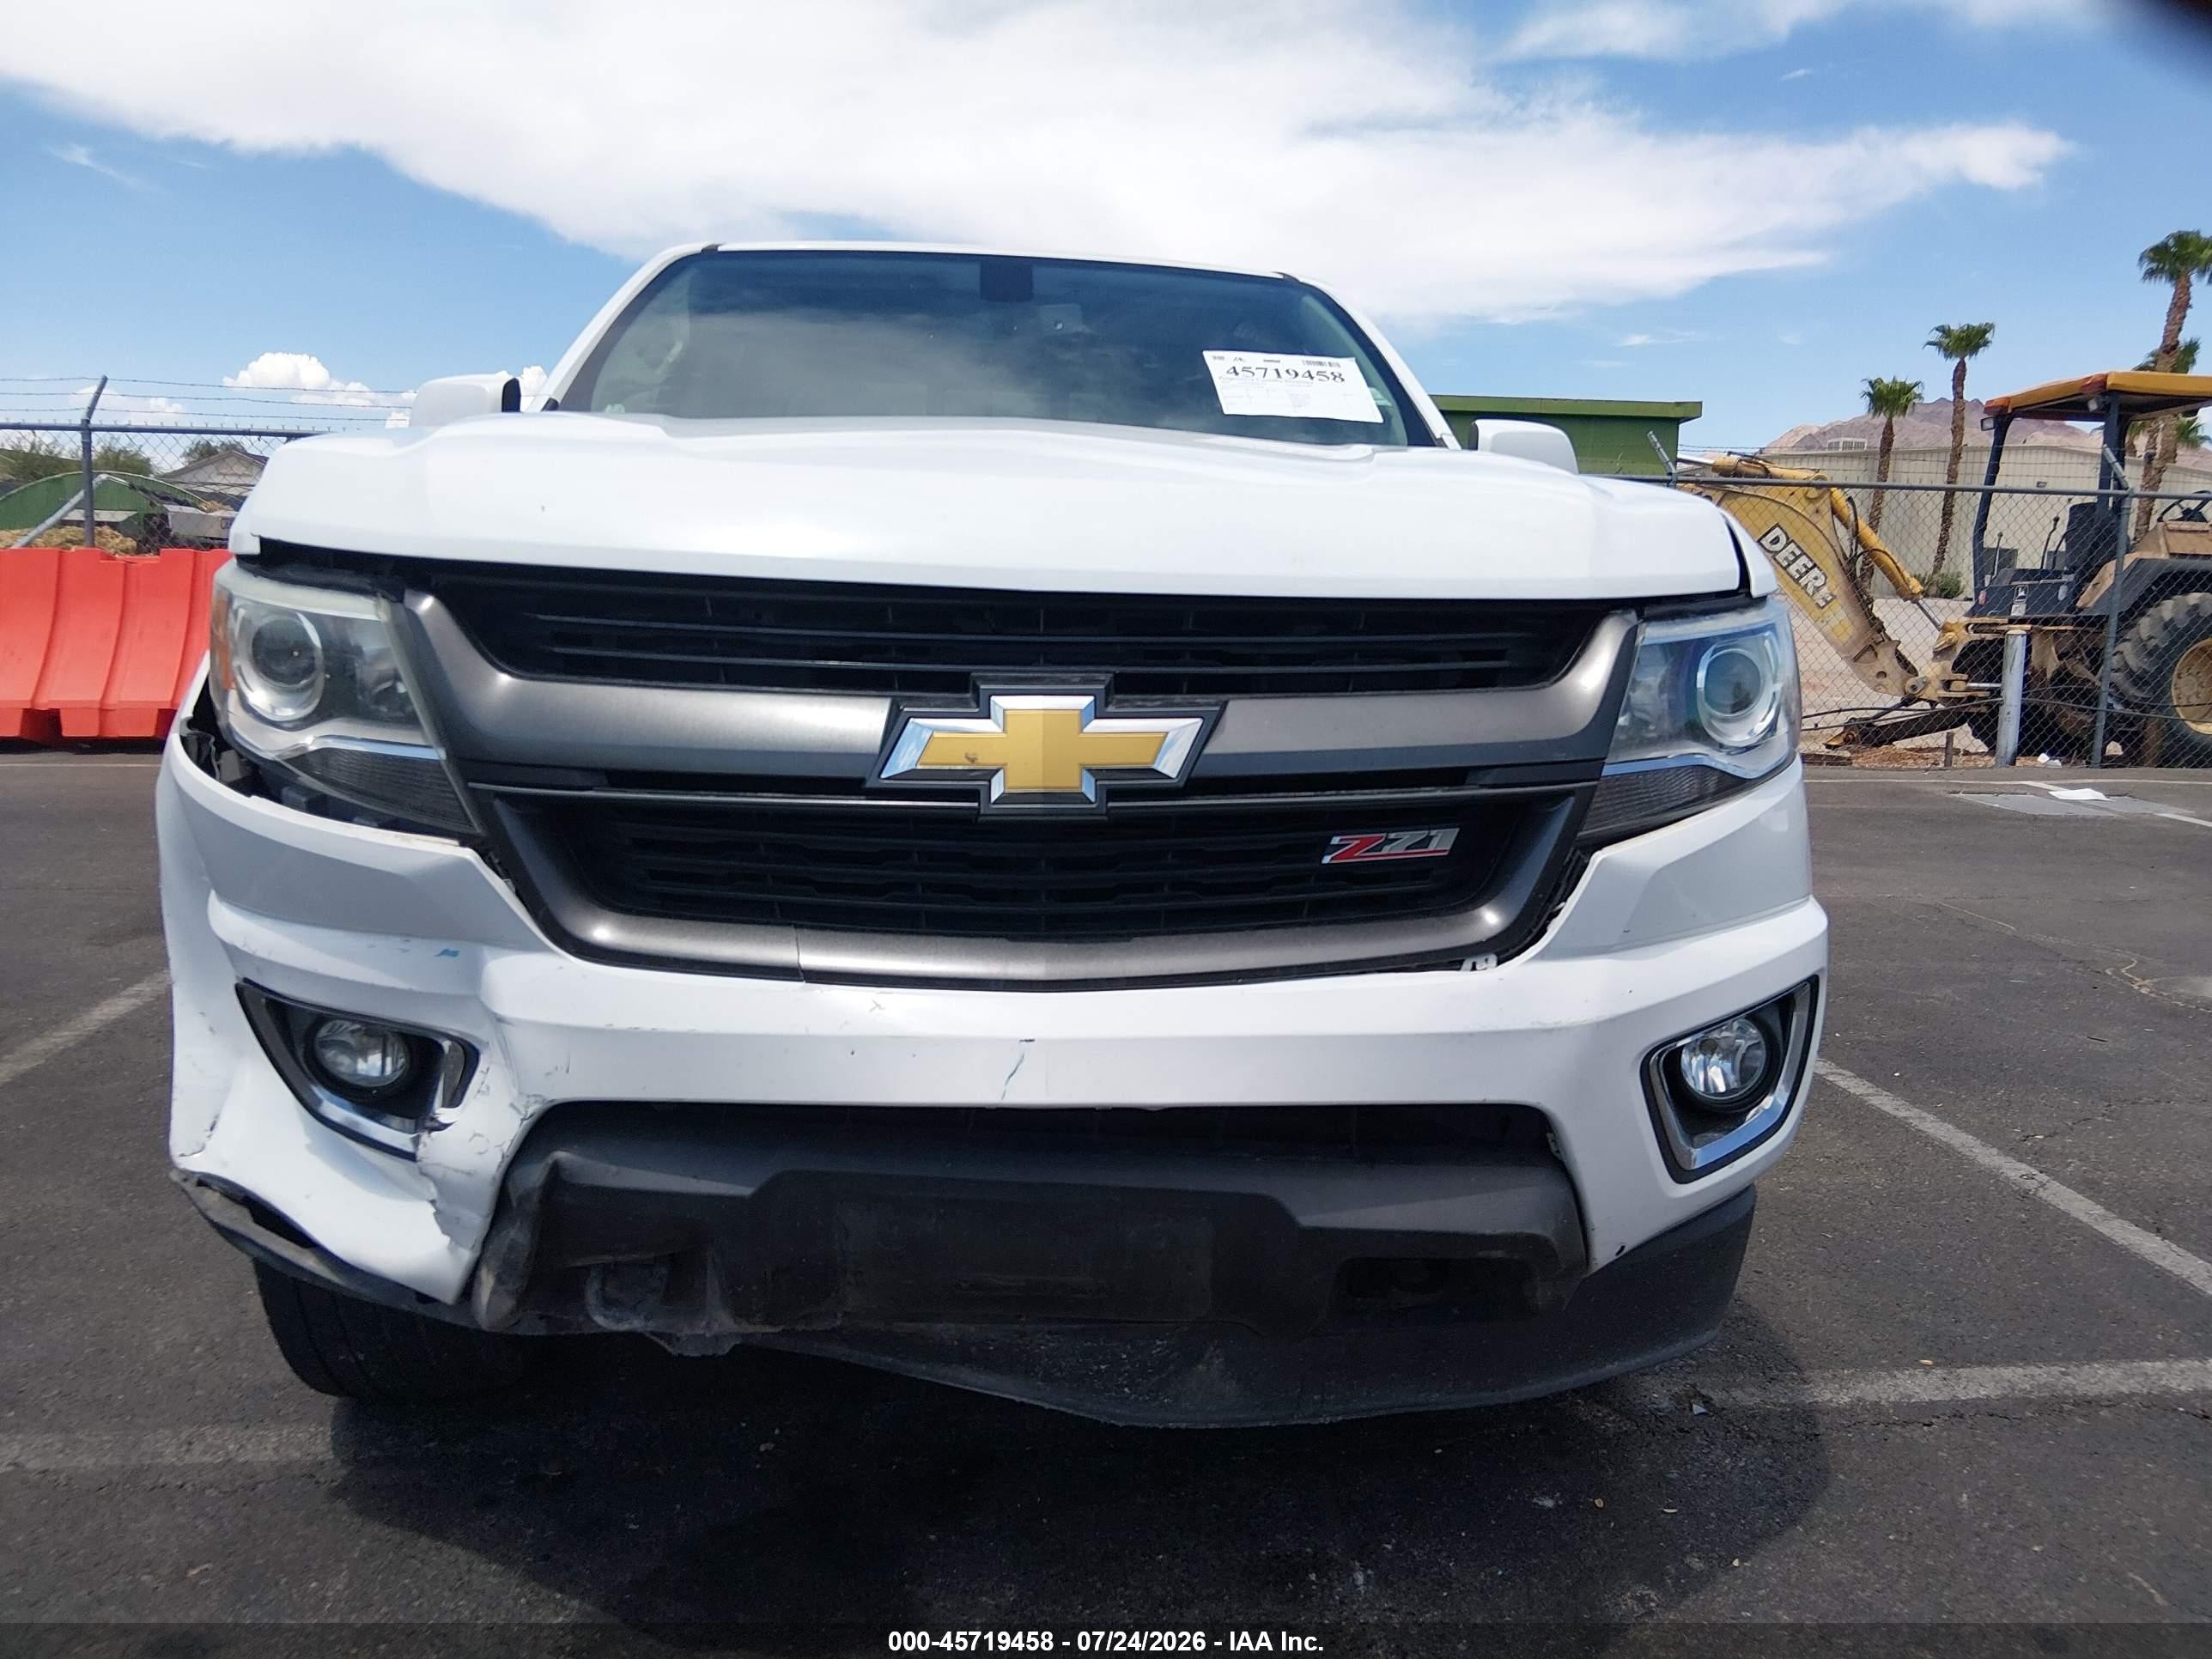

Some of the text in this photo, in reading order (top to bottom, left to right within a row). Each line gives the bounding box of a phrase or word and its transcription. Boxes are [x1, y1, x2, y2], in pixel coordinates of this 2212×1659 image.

[1226, 366, 1346, 383] 45719458
[1757, 523, 1836, 610] DEERE
[1322, 828, 1460, 864] Z71
